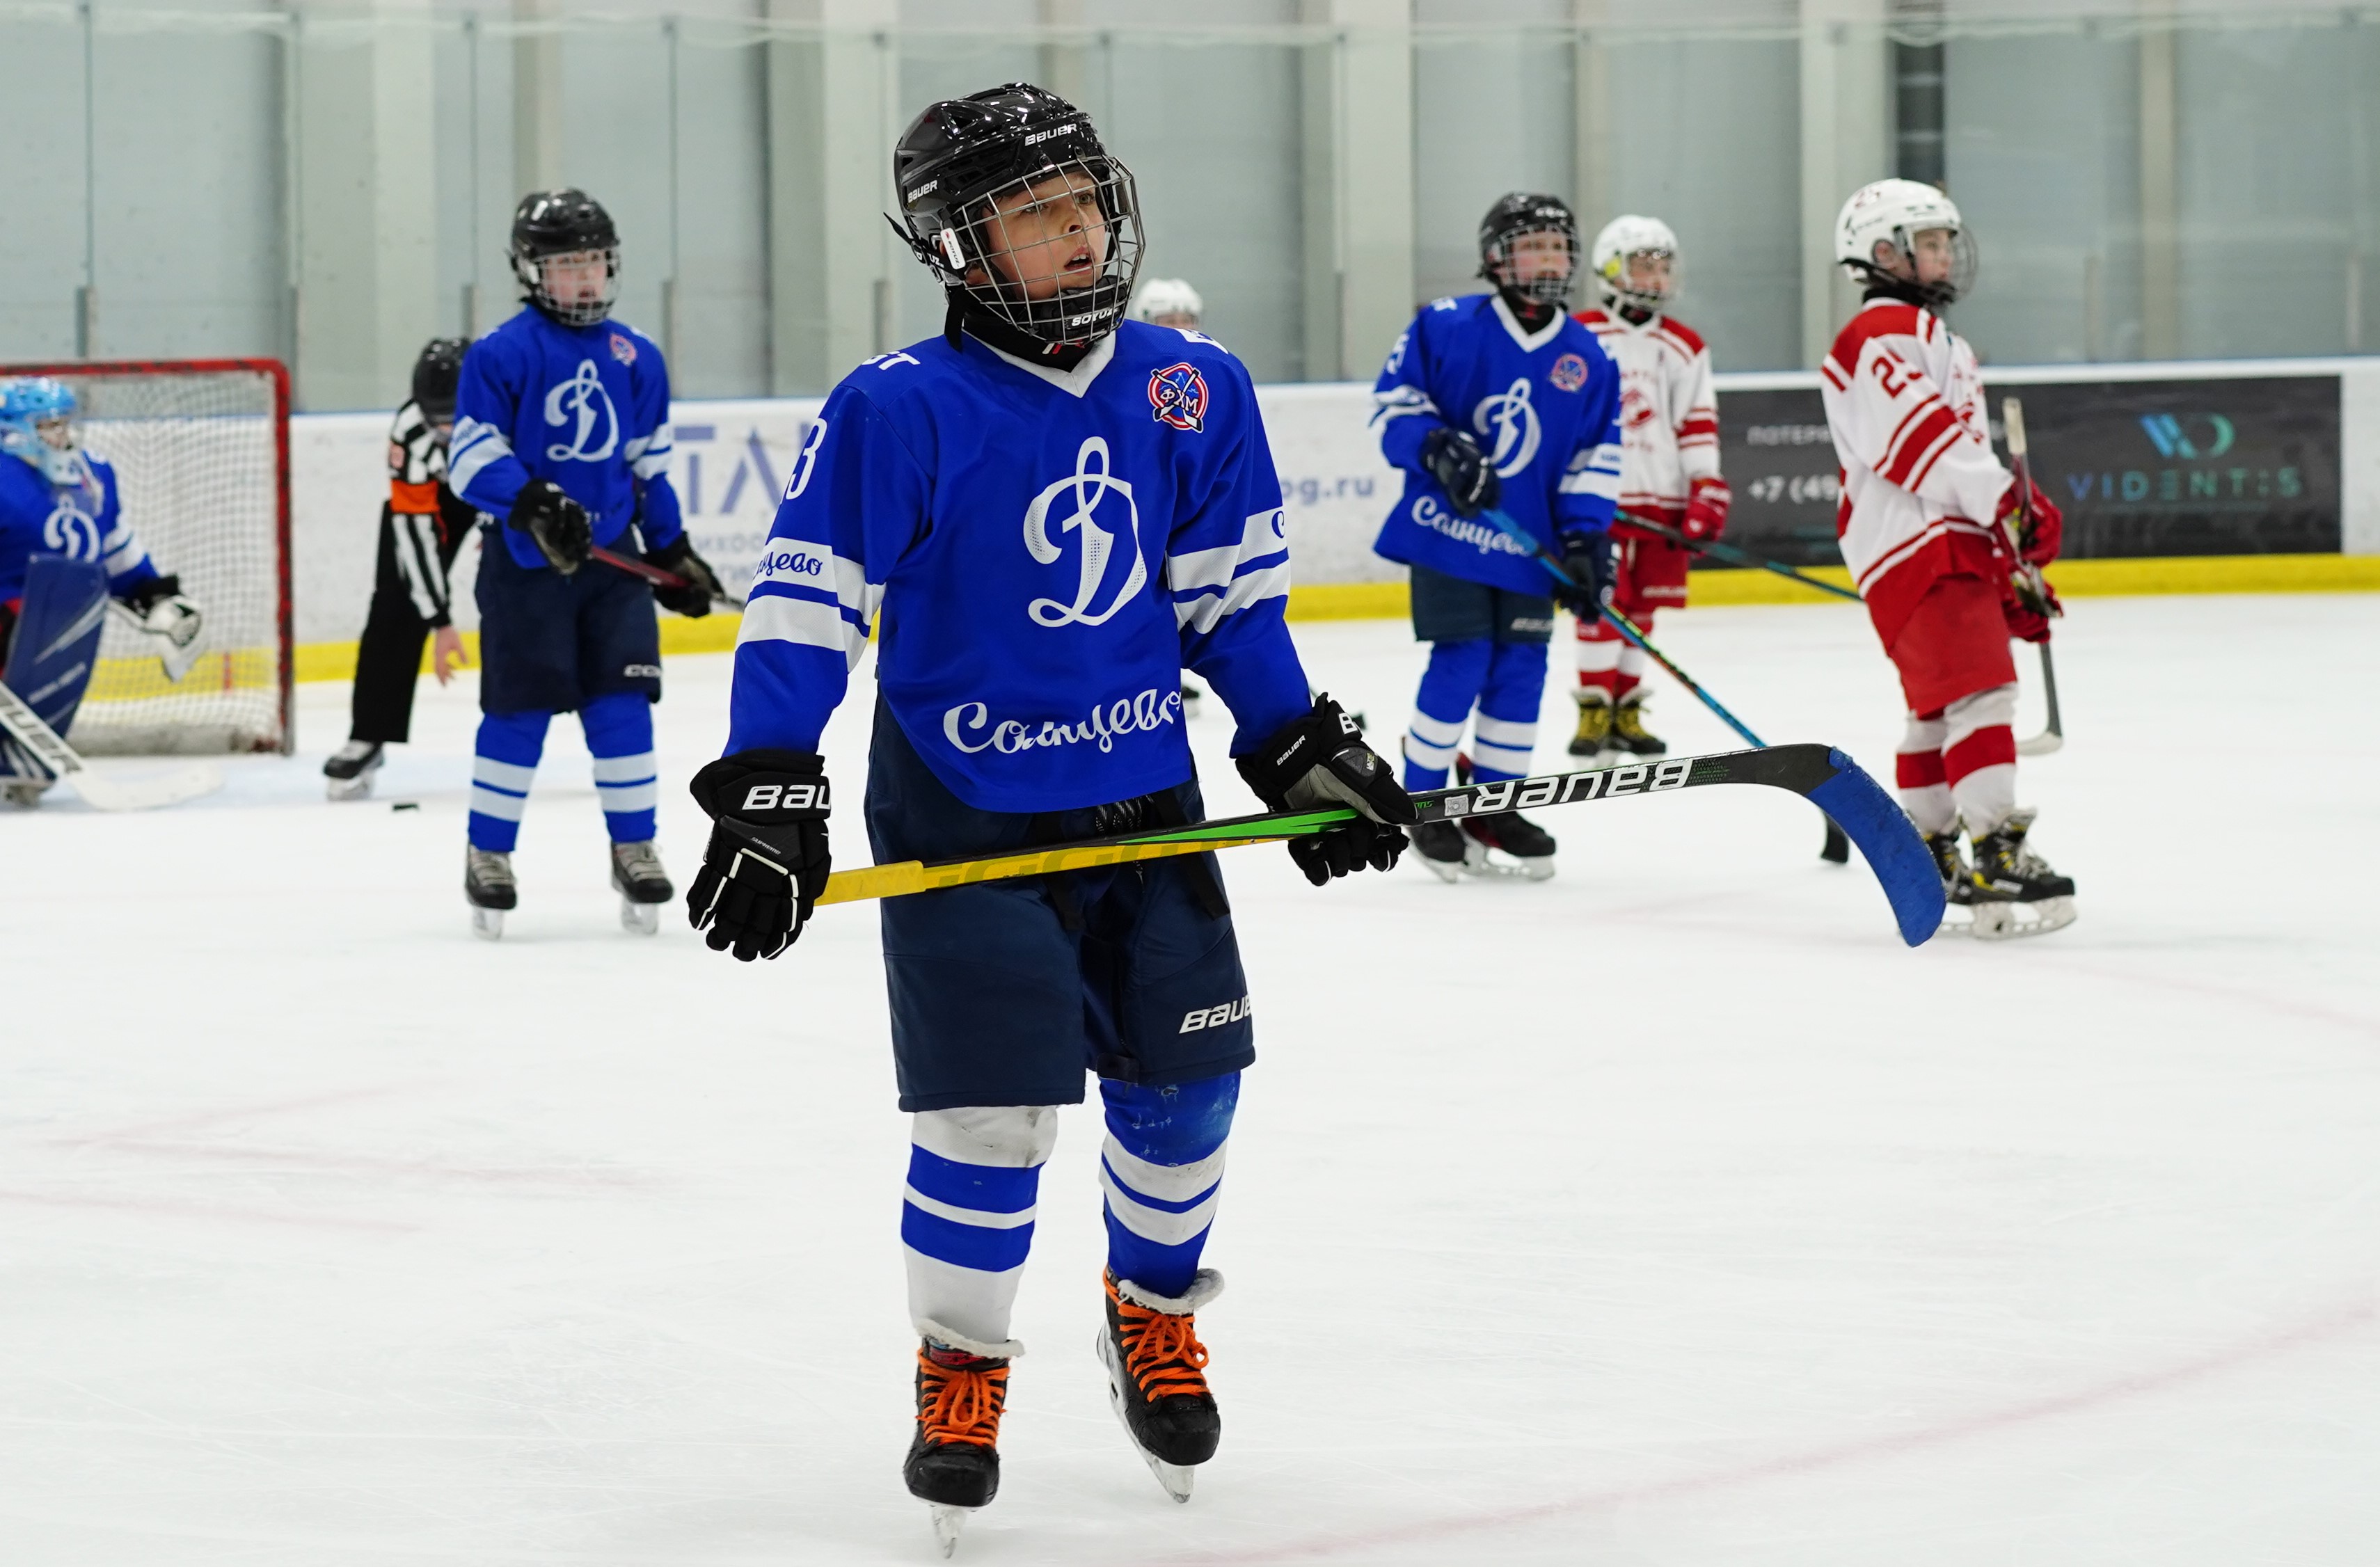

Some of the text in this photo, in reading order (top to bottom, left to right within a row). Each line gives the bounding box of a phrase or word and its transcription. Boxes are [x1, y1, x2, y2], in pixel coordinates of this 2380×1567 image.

[1024, 122, 1078, 147] BAUER
[907, 179, 938, 204] BAUER
[779, 417, 827, 504] 3
[1276, 735, 1306, 765] BAUER
[1471, 758, 1693, 814] BAUER
